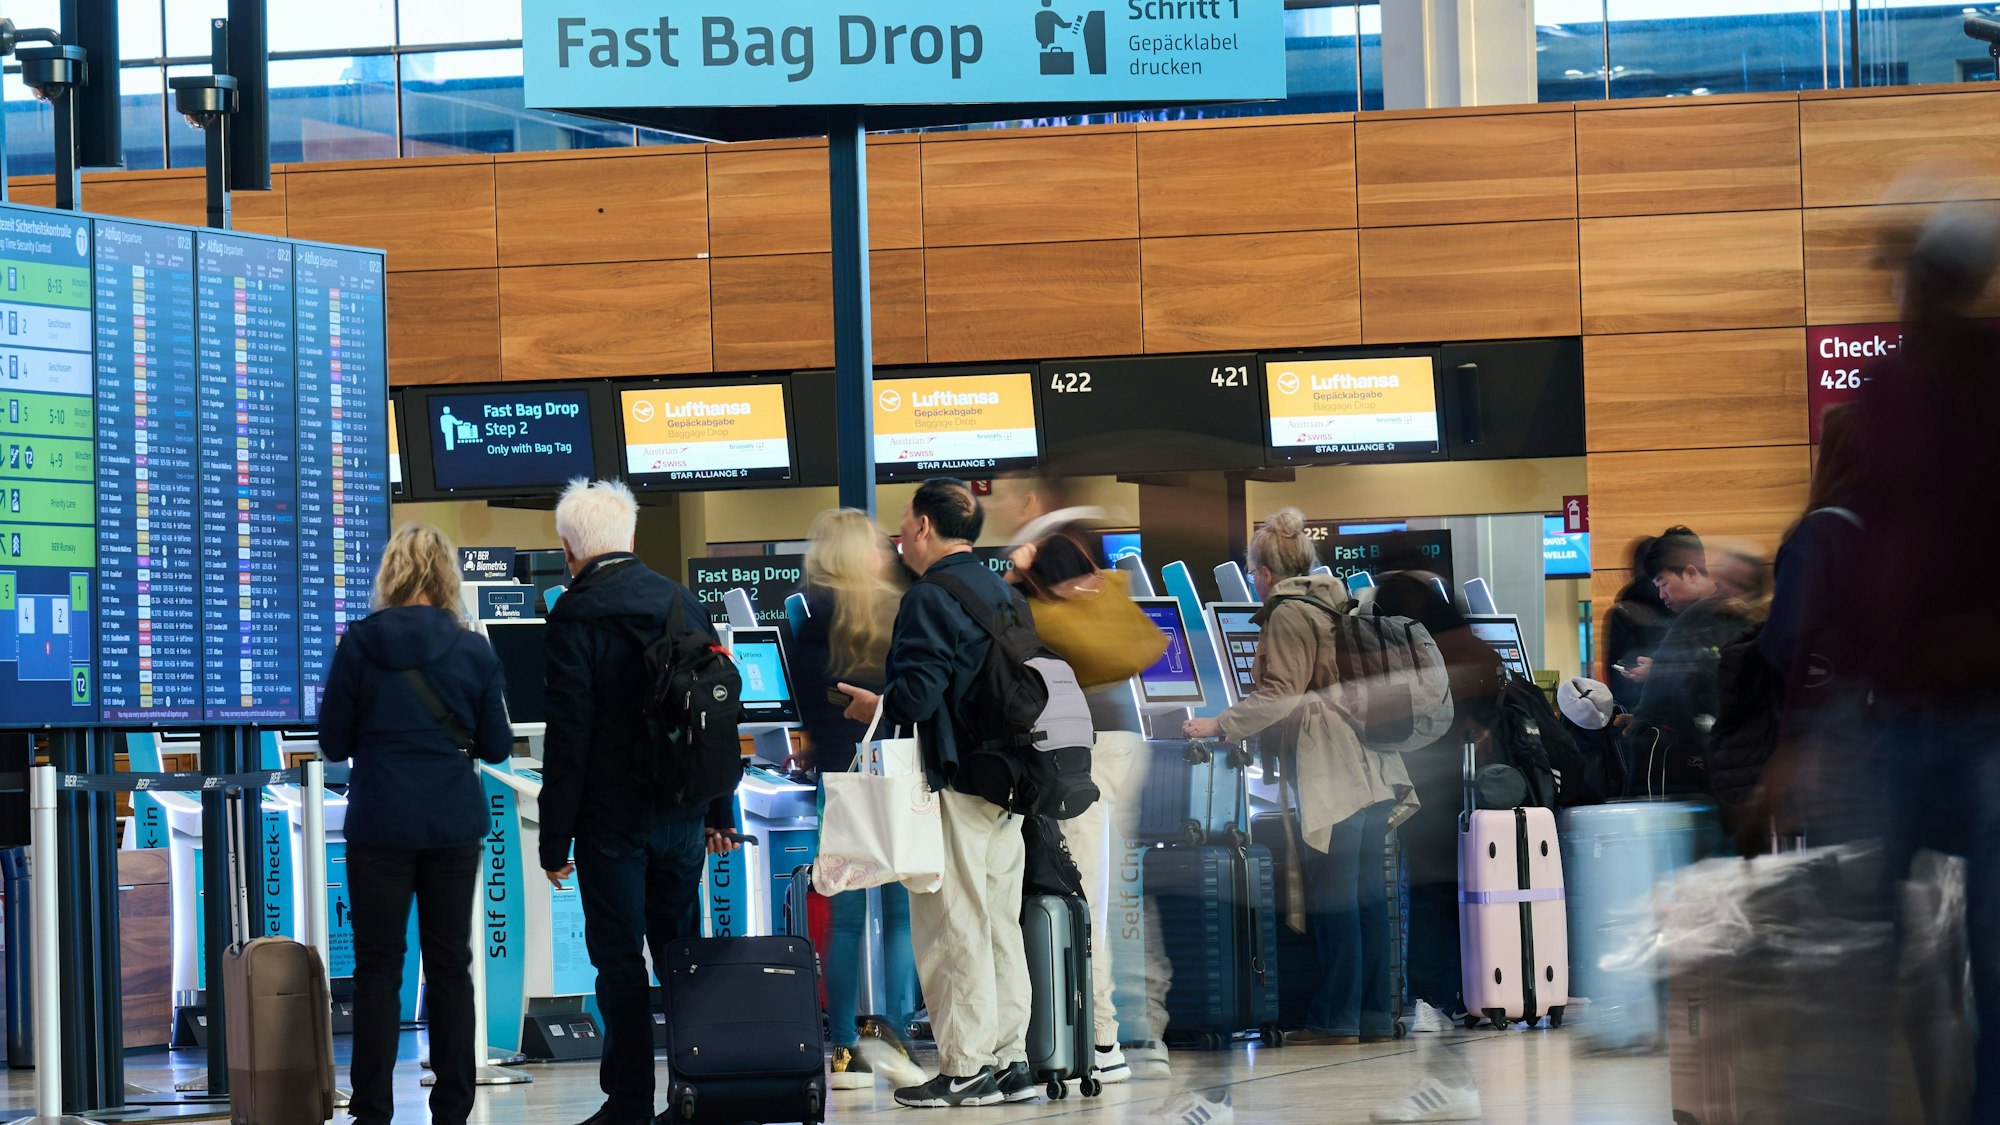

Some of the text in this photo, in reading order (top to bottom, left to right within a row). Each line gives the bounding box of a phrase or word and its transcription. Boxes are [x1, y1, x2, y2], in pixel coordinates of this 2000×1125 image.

[1128, 0, 1220, 19] Schritt
[557, 15, 983, 82] Fast Bag Drop
[1129, 33, 1239, 55] Gepäcklabel
[1130, 58, 1202, 75] drucken
[0, 217, 72, 238] ezeit Sicherheitskontrolle
[105, 226, 142, 244] Abflug Departure
[17, 240, 35, 254] Security
[35, 241, 52, 254] Control
[178, 236, 191, 250] 07:21
[207, 239, 243, 257] Abflug Departure
[278, 249, 290, 262] 07:21
[304, 252, 338, 268] Abflug Departure
[48, 278, 62, 294] 8-13
[1820, 335, 1903, 359] Check-i
[23, 363, 28, 377] 4
[1211, 366, 1248, 388] 421
[1051, 372, 1092, 393] 422
[1311, 373, 1399, 390] Lufthansa
[912, 390, 999, 407] Lufthansa
[1313, 390, 1382, 402] Gepäckabgabe
[484, 402, 579, 420] Fast Bag Drop
[665, 401, 751, 418] Lufthansa
[914, 407, 982, 419] Gepäckabgabe
[1313, 400, 1376, 412] Baggage Drop
[24, 407, 65, 425] 5 5-10
[667, 417, 735, 429] Gepäckabgabe
[915, 417, 976, 429] Baggage Drop
[486, 421, 528, 438] Step 2
[1288, 419, 1324, 429] Austrian
[668, 428, 729, 440] Baggage Drop
[889, 435, 925, 446] Austrian
[1307, 433, 1332, 442] SWISS
[487, 442, 572, 457] Only with Bag Tag
[642, 446, 679, 457] Austrian
[909, 449, 934, 458] SWISS
[1315, 443, 1385, 454] STAR ALLIANCE
[50, 453, 63, 468] 4-9
[662, 459, 687, 468] SWISS
[917, 459, 985, 470] STAR ALLIANCE
[671, 469, 738, 480] STAR ALLIANCE
[1543, 537, 1567, 546] WAYS
[477, 551, 489, 560] BER
[1335, 545, 1365, 560] Fast
[477, 561, 507, 571] Biometrics
[989, 558, 1015, 571] Dro
[698, 567, 800, 585] Fast Bag Drop
[5, 584, 9, 600] 5
[751, 589, 758, 600] 2
[24, 608, 29, 623] 4
[58, 608, 63, 623] 2
[65, 775, 77, 787] BER
[135, 779, 150, 790] BER
[203, 777, 217, 788] BER
[269, 772, 282, 784] BER
[487, 794, 506, 958] Self Check-in
[267, 903, 280, 938] elf
[715, 896, 731, 938] Self
[1120, 892, 1140, 939] Self
